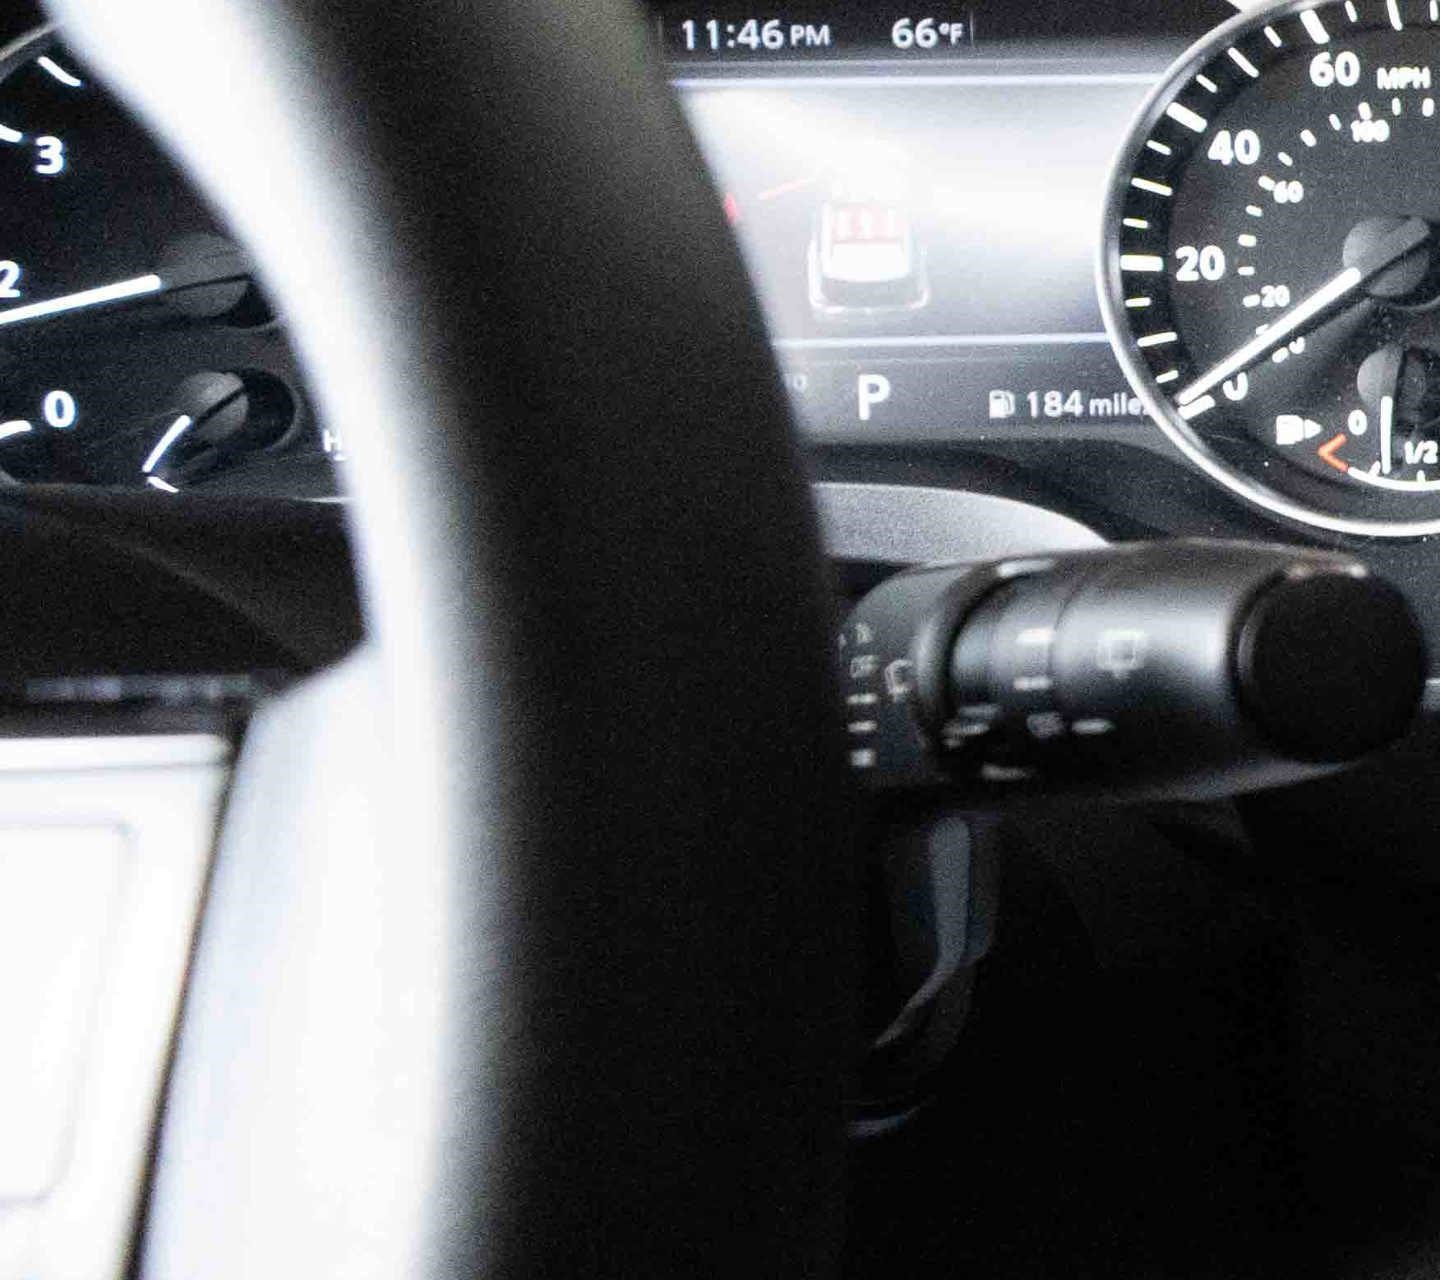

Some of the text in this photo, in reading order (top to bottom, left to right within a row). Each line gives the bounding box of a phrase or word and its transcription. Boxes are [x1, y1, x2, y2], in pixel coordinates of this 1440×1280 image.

[682, 19, 830, 49] 11:46 PM
[891, 18, 963, 48] 66°F
[1310, 51, 1359, 86] 60
[1377, 67, 1430, 89] MPH
[34, 136, 66, 174] 3
[1208, 130, 1260, 165] 40
[1273, 181, 1303, 202] 60
[1176, 246, 1225, 281] 20
[1260, 285, 1290, 307] 20
[44, 390, 77, 427] 0
[858, 374, 891, 420] P
[1027, 390, 1146, 418] 184 mile
[1348, 410, 1367, 435] 0
